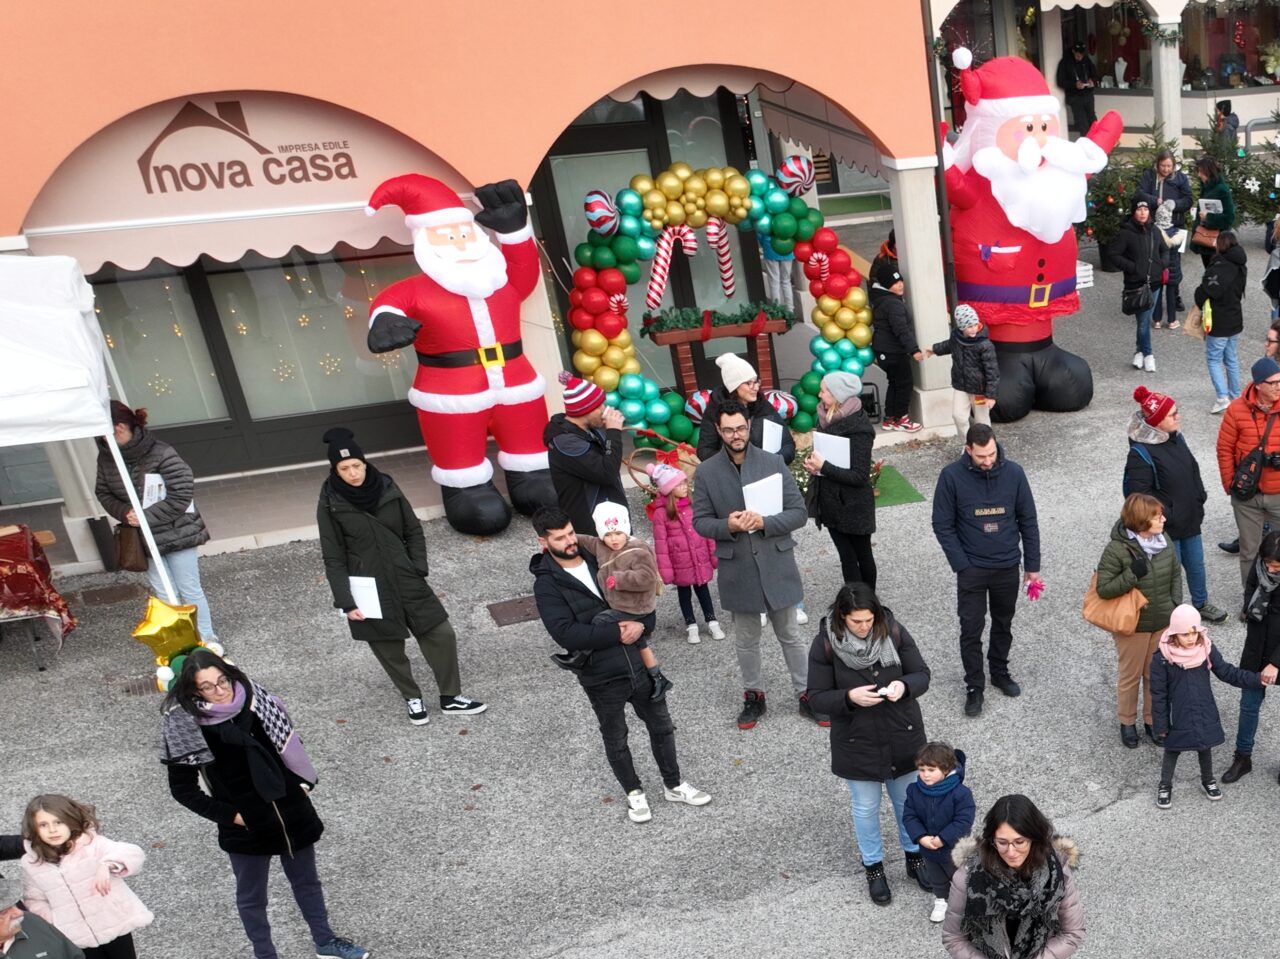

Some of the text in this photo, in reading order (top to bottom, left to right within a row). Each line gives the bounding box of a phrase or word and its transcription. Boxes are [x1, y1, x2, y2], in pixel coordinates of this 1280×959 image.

[277, 140, 350, 154] IMPRESA EDILE
[152, 152, 358, 193] nova casa
